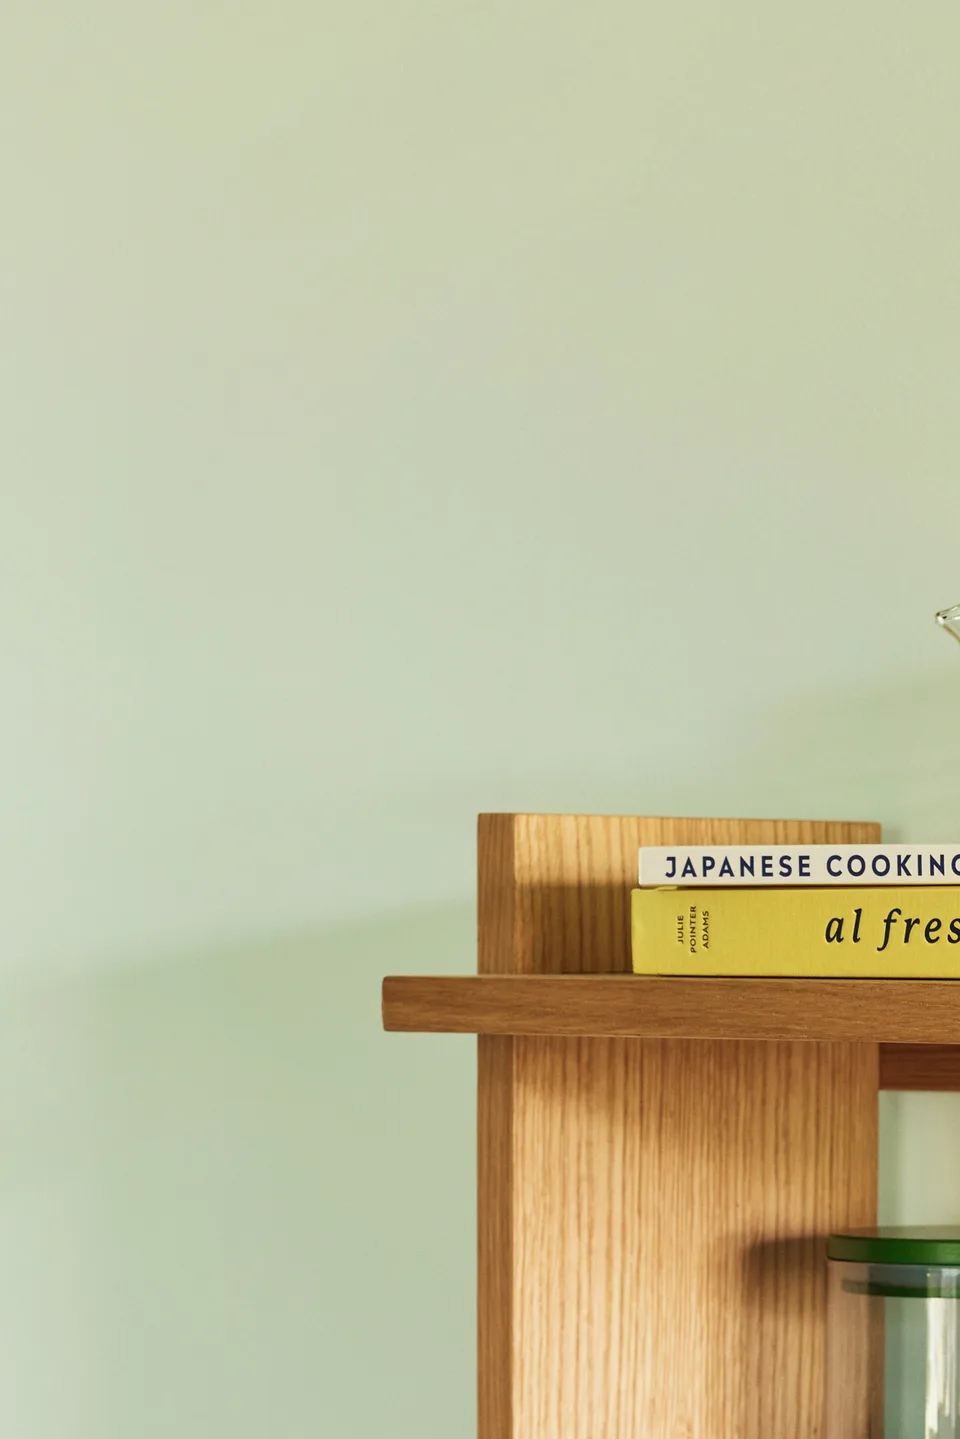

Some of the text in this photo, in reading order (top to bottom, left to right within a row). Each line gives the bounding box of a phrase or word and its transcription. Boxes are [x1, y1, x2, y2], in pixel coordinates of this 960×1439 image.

[664, 855, 811, 878] JAPANESE
[689, 905, 697, 954] POINTER
[825, 908, 863, 944] al
